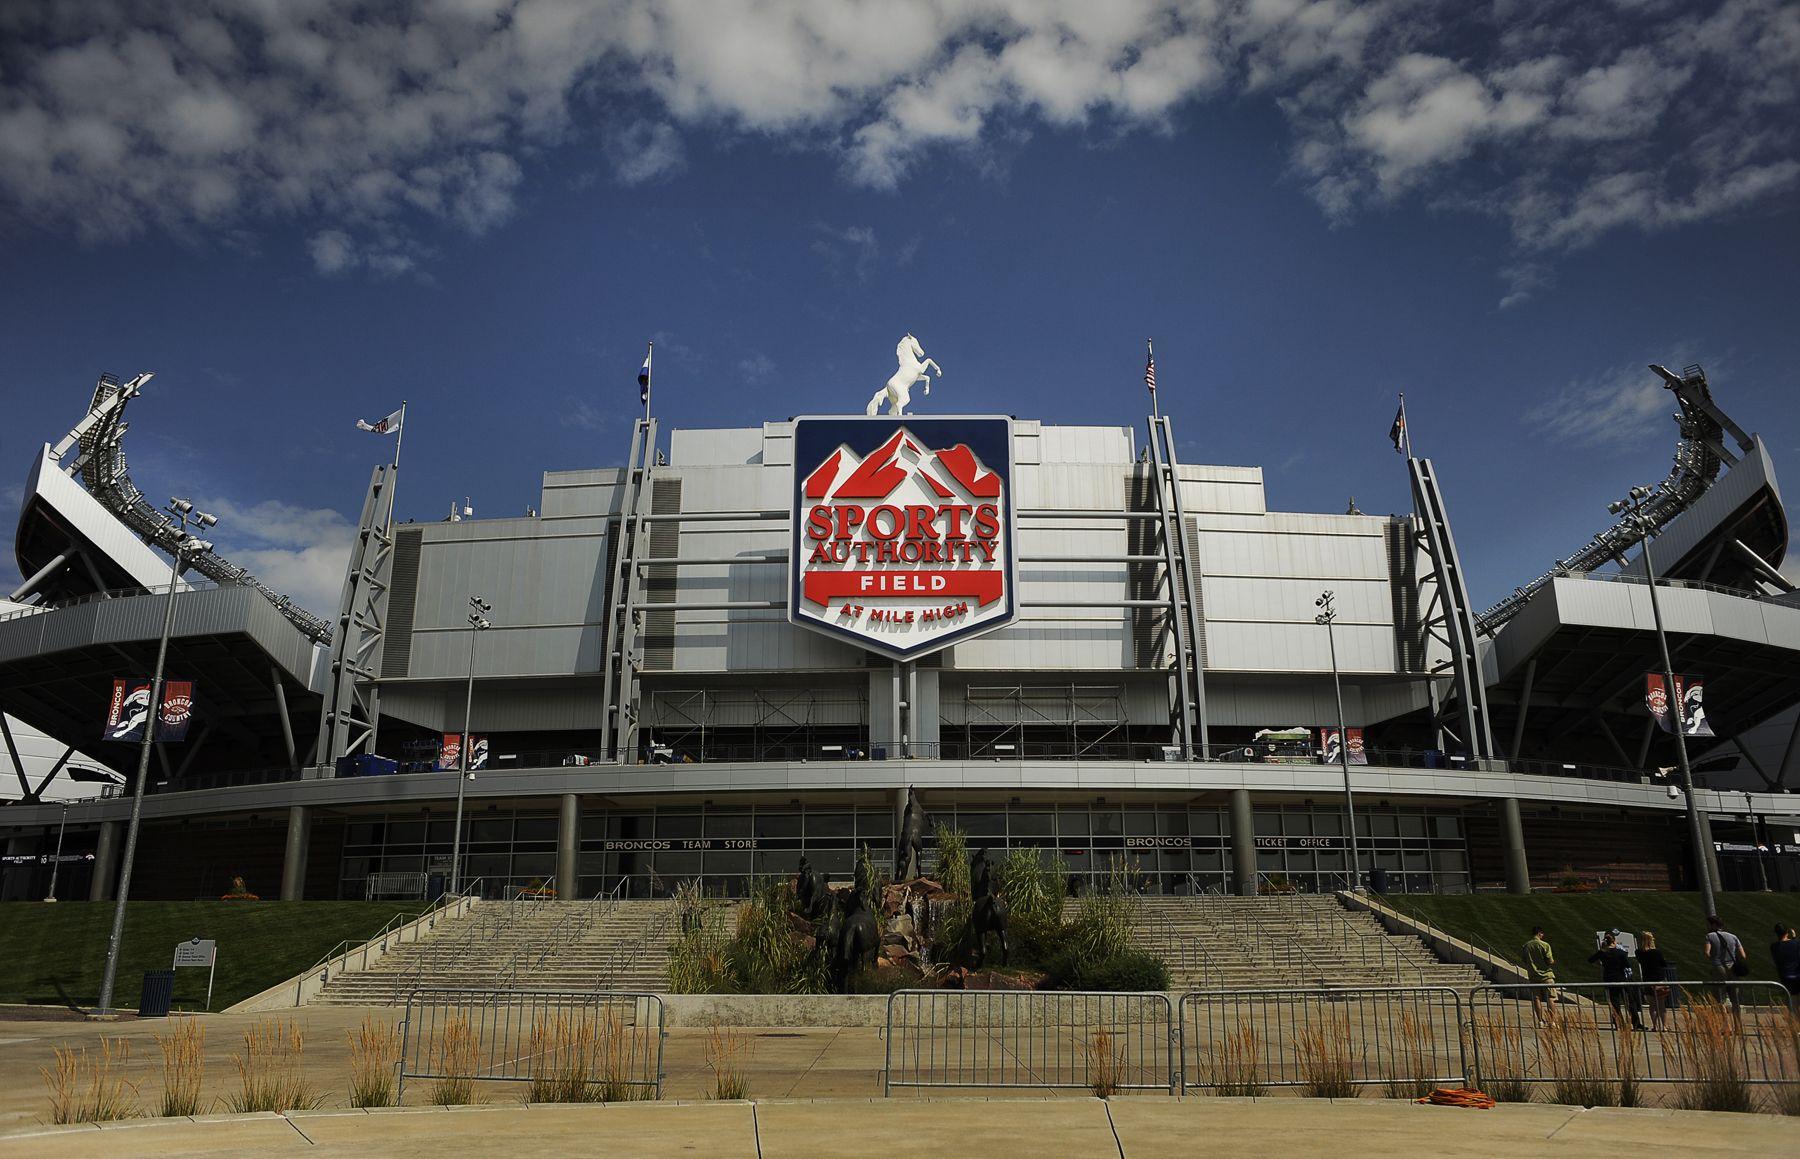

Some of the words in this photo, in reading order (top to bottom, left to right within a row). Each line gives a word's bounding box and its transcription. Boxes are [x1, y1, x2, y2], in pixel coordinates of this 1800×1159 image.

[808, 504, 1000, 540] SPORTS
[808, 541, 999, 563] AUTHORITY
[860, 575, 947, 591] FIELD
[840, 602, 864, 618] AT
[871, 609, 914, 623] MILE
[923, 601, 968, 622] HIGH
[109, 686, 123, 726] BRONCOS
[1676, 682, 1686, 723] BRONCOS
[606, 841, 671, 850] BRONCOS
[682, 841, 711, 849] TEAM
[724, 840, 758, 849] STORE
[1126, 837, 1192, 847] BRONCOS
[1256, 838, 1288, 847] TICKET
[1300, 838, 1330, 847] OFFICE
